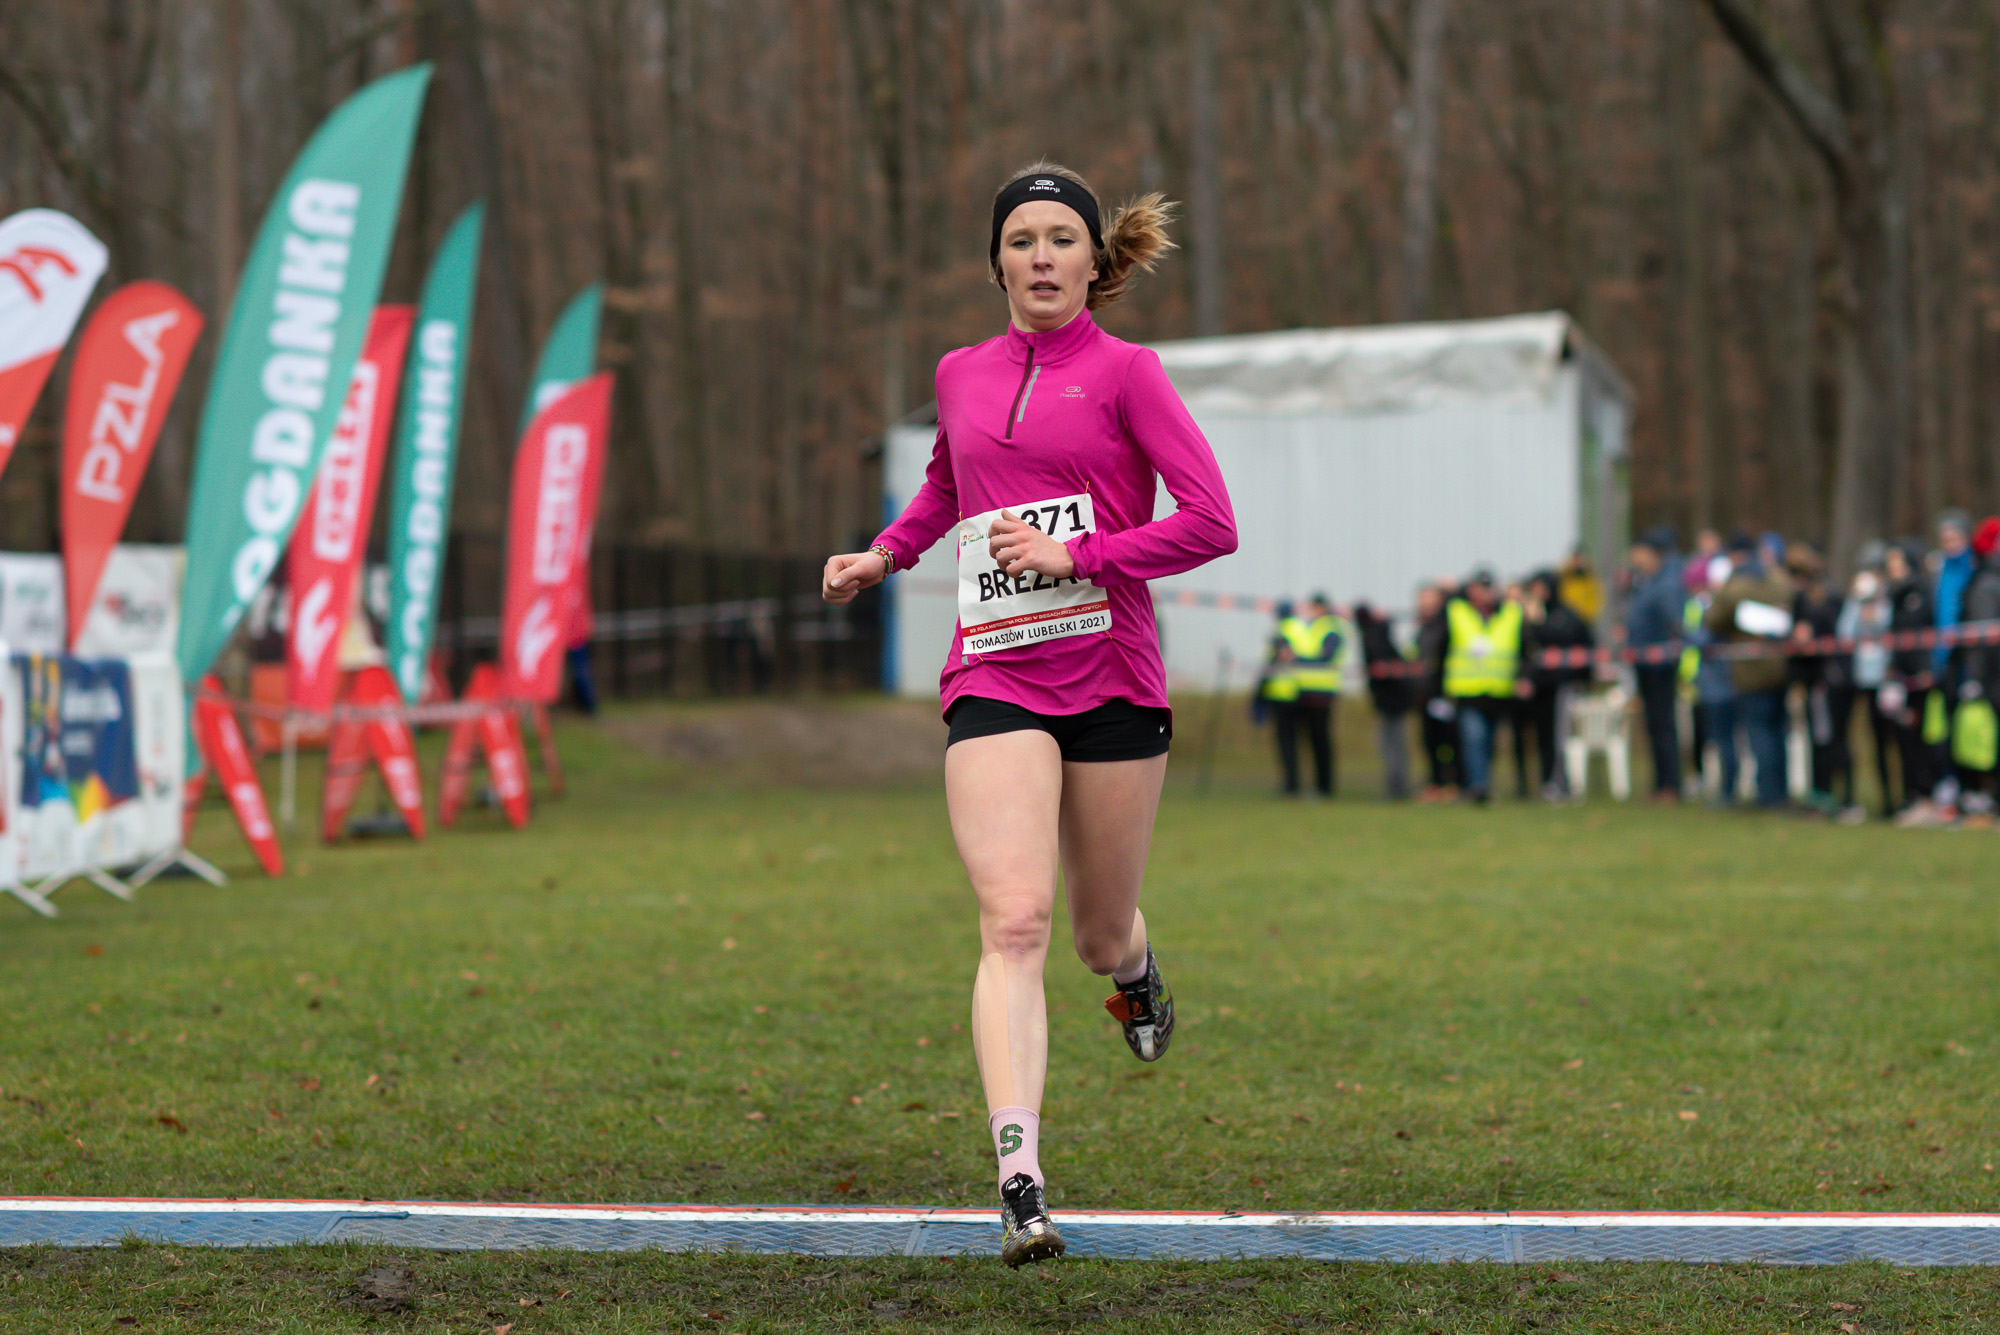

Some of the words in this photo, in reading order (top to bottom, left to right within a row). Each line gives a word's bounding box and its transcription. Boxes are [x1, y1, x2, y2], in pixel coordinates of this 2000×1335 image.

[1029, 185, 1060, 193] Kalenji
[76, 308, 181, 503] PZLA
[221, 178, 361, 629] OGDANKA
[1021, 502, 1086, 536] 371
[971, 630, 1024, 650] TOMASZÓW
[1028, 621, 1077, 639] LUBELSKI
[1080, 616, 1106, 630] 2021
[1000, 1124, 1023, 1157] S
